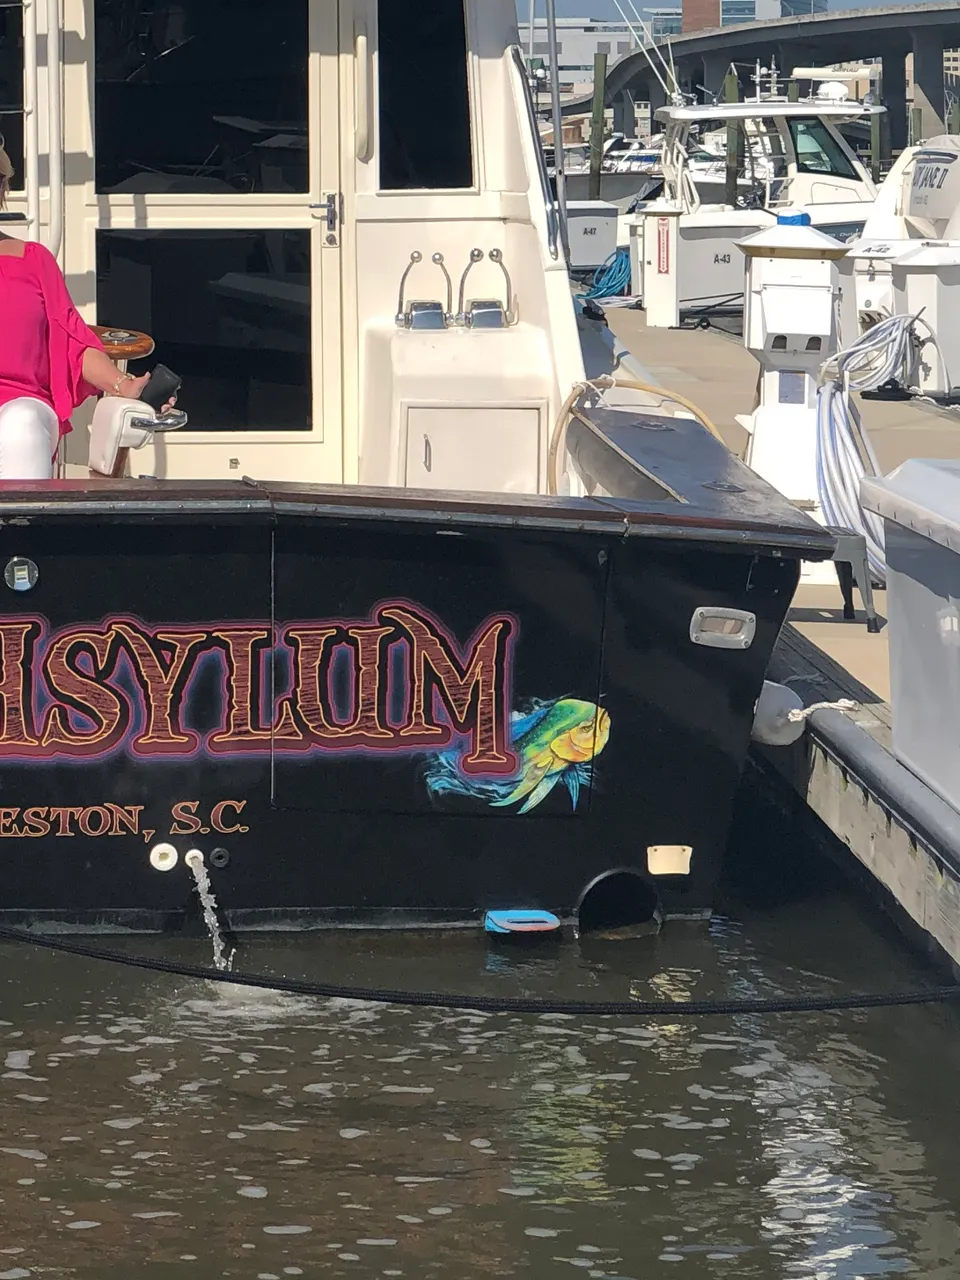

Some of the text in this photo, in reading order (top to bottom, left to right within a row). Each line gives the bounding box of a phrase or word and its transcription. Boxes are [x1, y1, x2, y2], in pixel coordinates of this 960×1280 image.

[583, 227, 597, 236] A-47
[713, 254, 731, 264] A-43
[170, 800, 249, 835] S.C.
